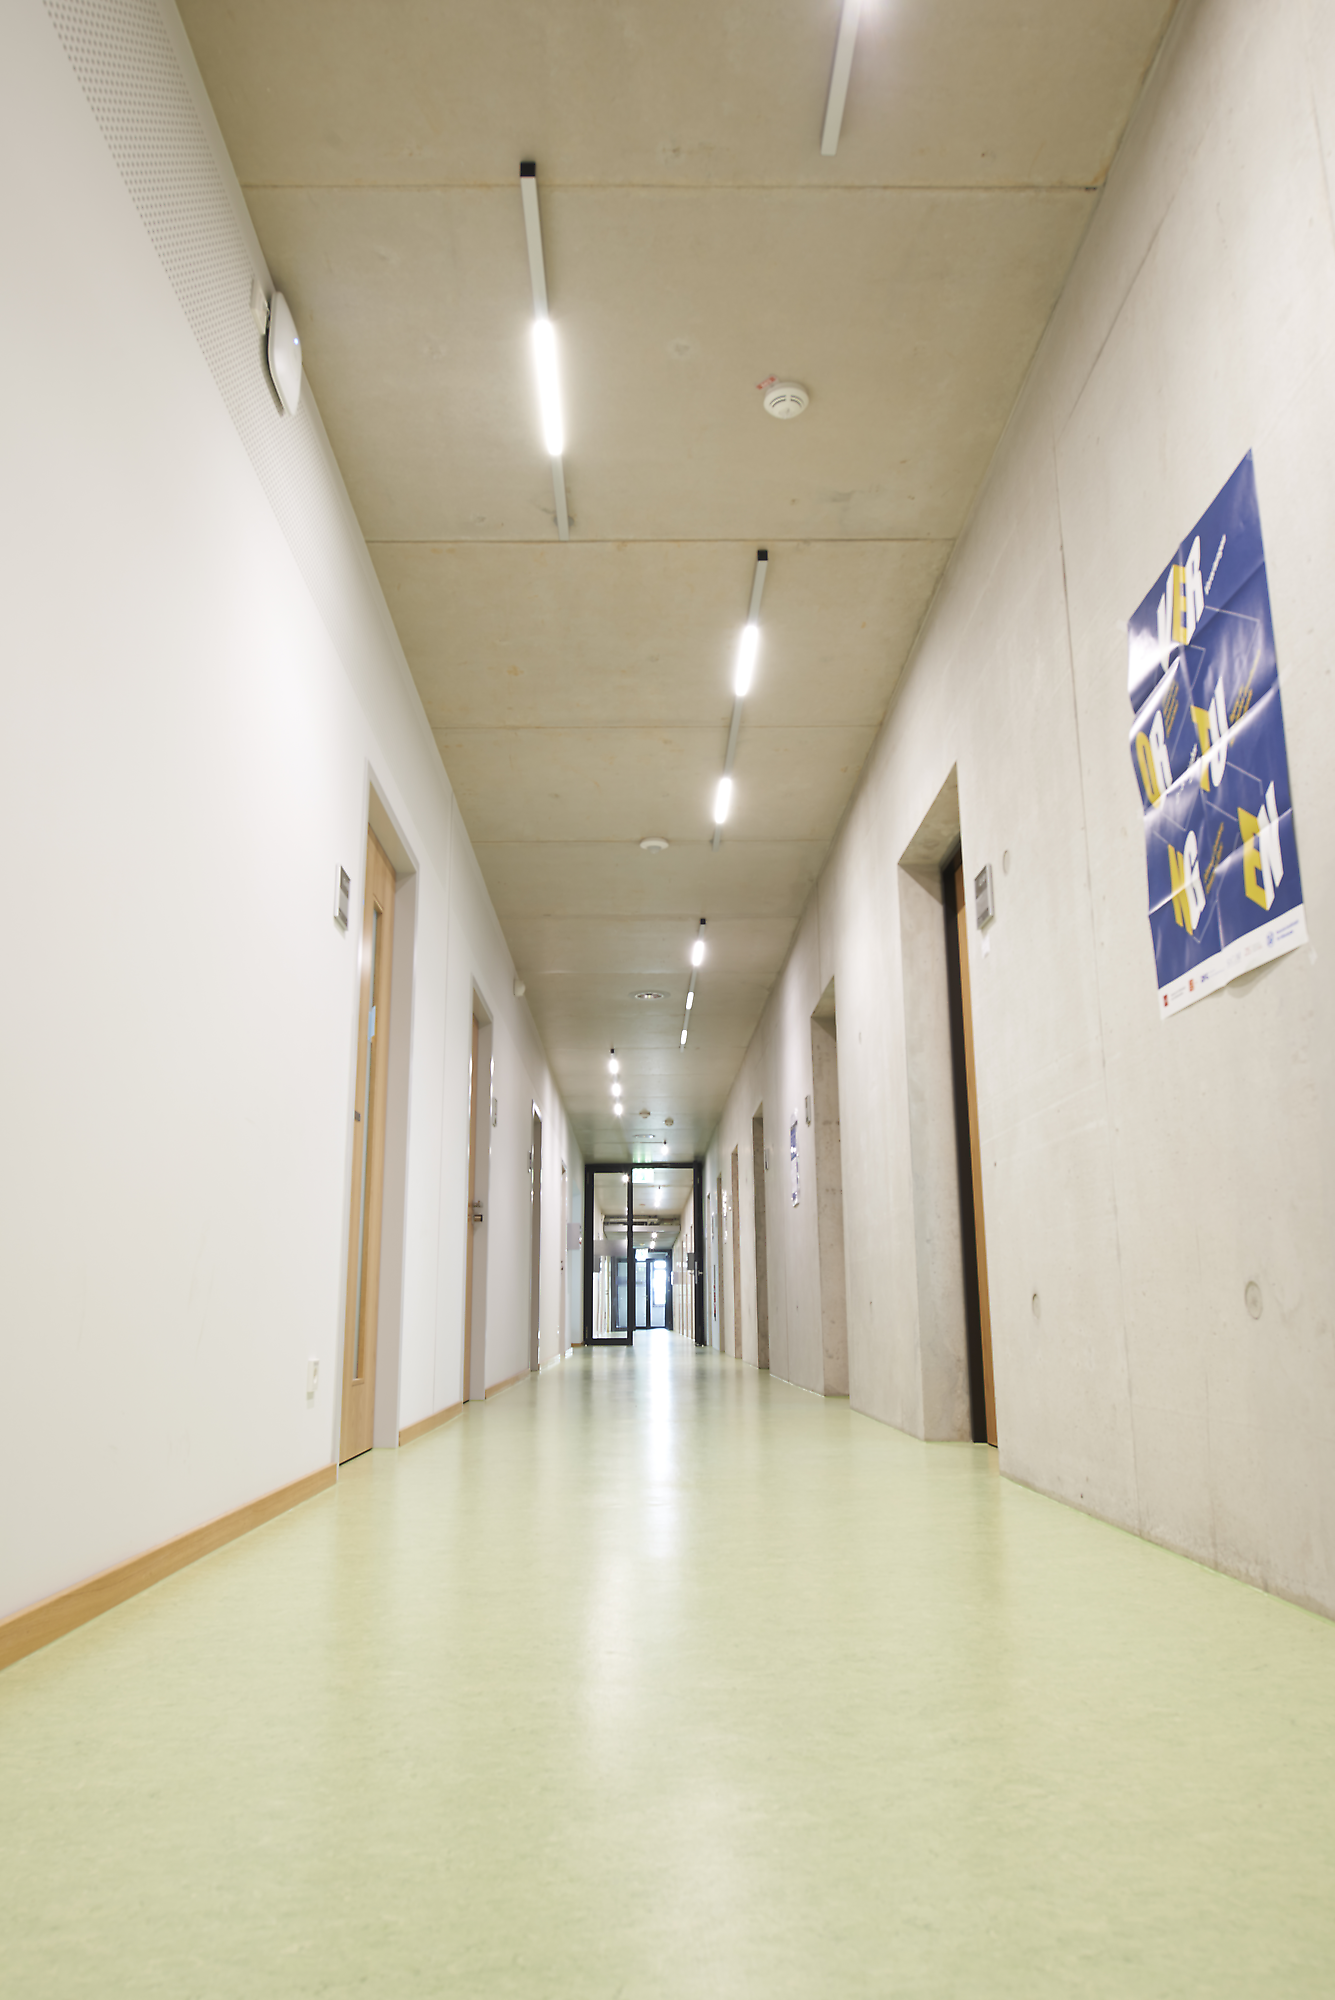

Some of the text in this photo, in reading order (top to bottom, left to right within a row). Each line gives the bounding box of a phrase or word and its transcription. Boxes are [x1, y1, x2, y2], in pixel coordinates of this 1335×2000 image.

[1157, 535, 1205, 674] VER
[1135, 709, 1173, 808] OR
[1190, 676, 1229, 793] TU
[1237, 780, 1284, 912] EN
